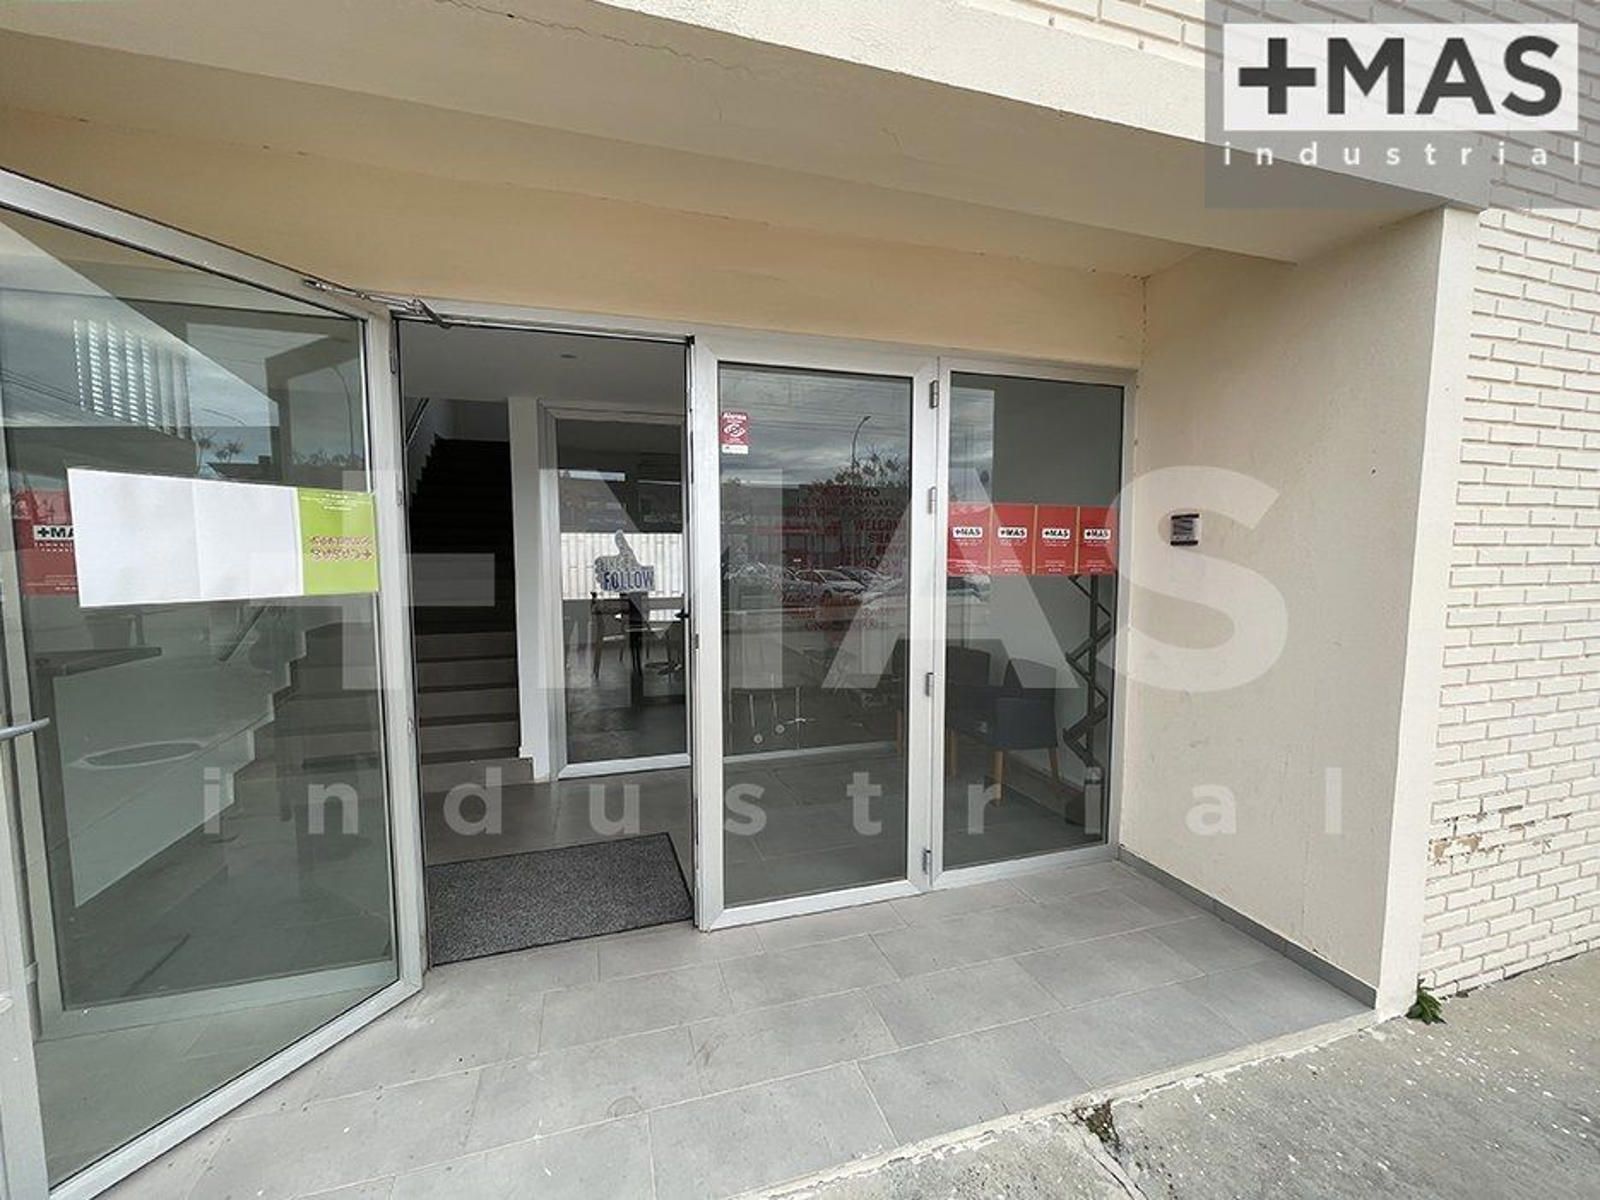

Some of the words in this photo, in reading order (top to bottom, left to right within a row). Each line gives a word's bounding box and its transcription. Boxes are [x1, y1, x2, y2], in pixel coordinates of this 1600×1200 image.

[999, 528, 1026, 537] +MAS
[1043, 529, 1069, 538] +MAS
[603, 571, 655, 590] FOLLOW
